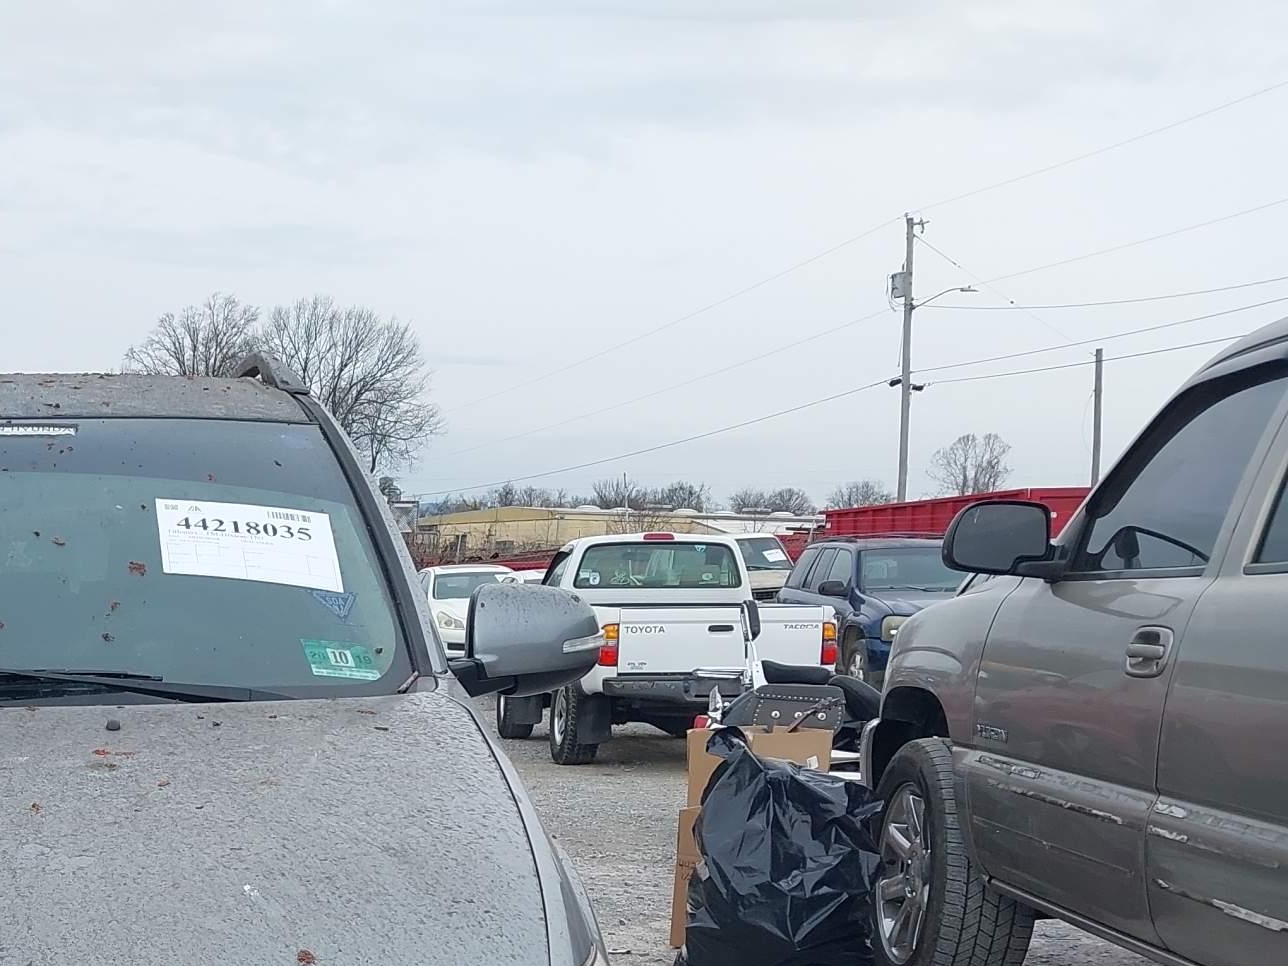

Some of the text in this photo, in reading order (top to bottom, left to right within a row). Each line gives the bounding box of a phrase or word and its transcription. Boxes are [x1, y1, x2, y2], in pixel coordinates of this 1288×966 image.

[177, 516, 312, 541] 44218035
[624, 626, 665, 634] TOYOTA
[330, 650, 349, 665] 10
